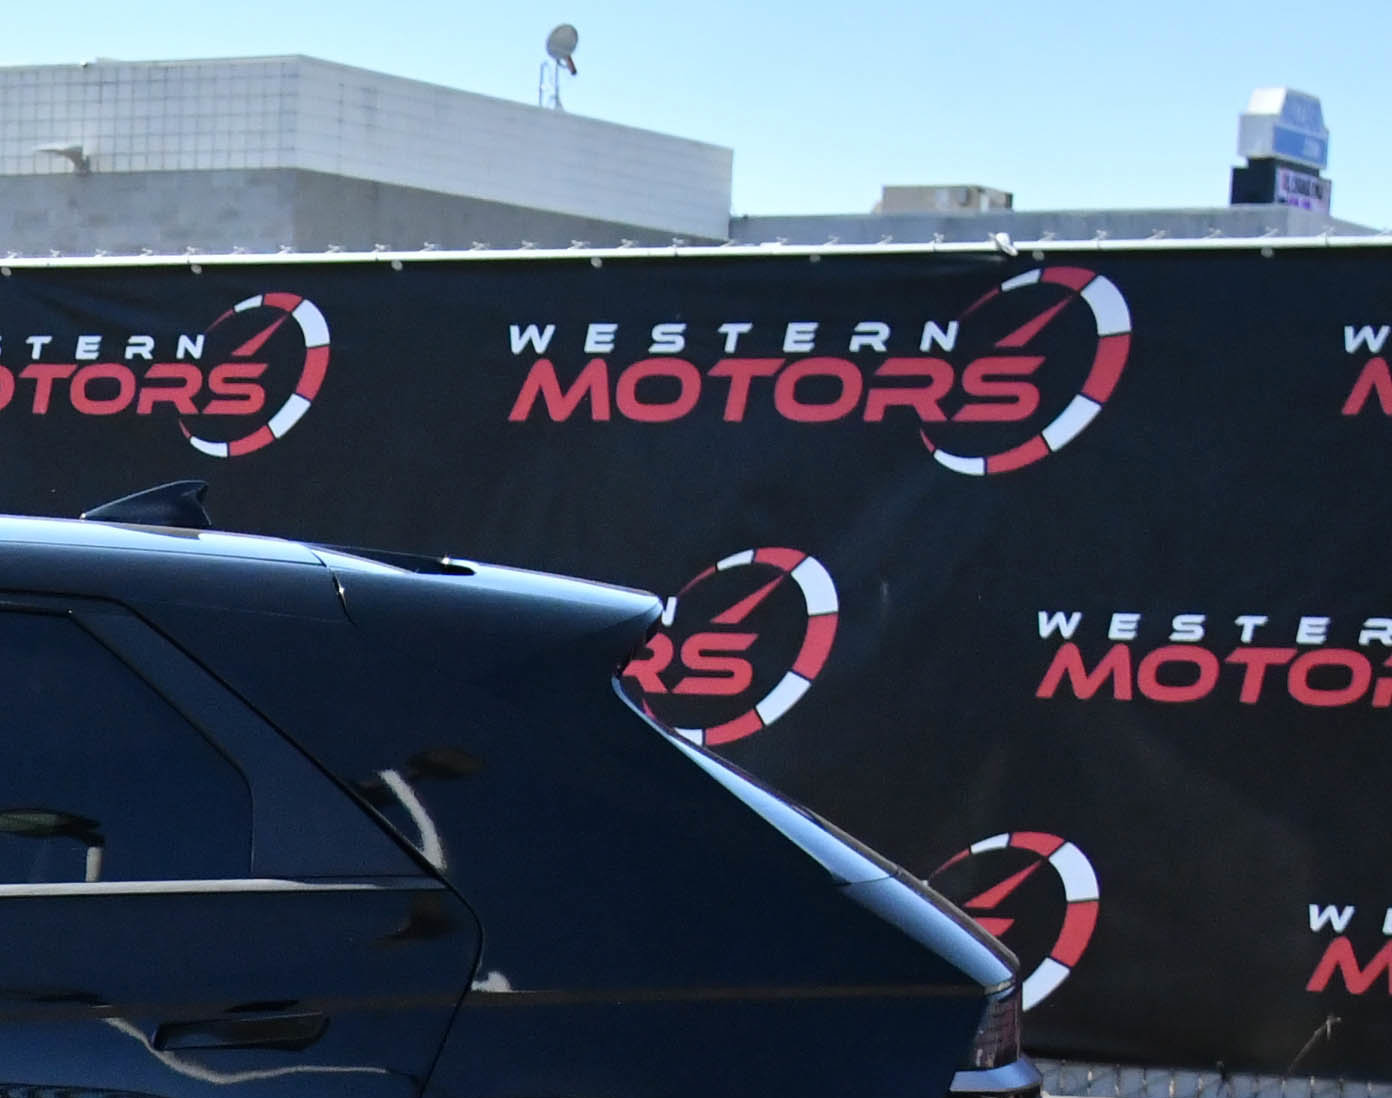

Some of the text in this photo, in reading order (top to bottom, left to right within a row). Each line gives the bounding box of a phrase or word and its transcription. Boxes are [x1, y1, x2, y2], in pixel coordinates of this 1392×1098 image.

[509, 320, 959, 355] WESTERN
[508, 355, 1045, 423] MOTORS
[1037, 610, 1392, 646] WESTER
[1036, 641, 1392, 708] MOTO
